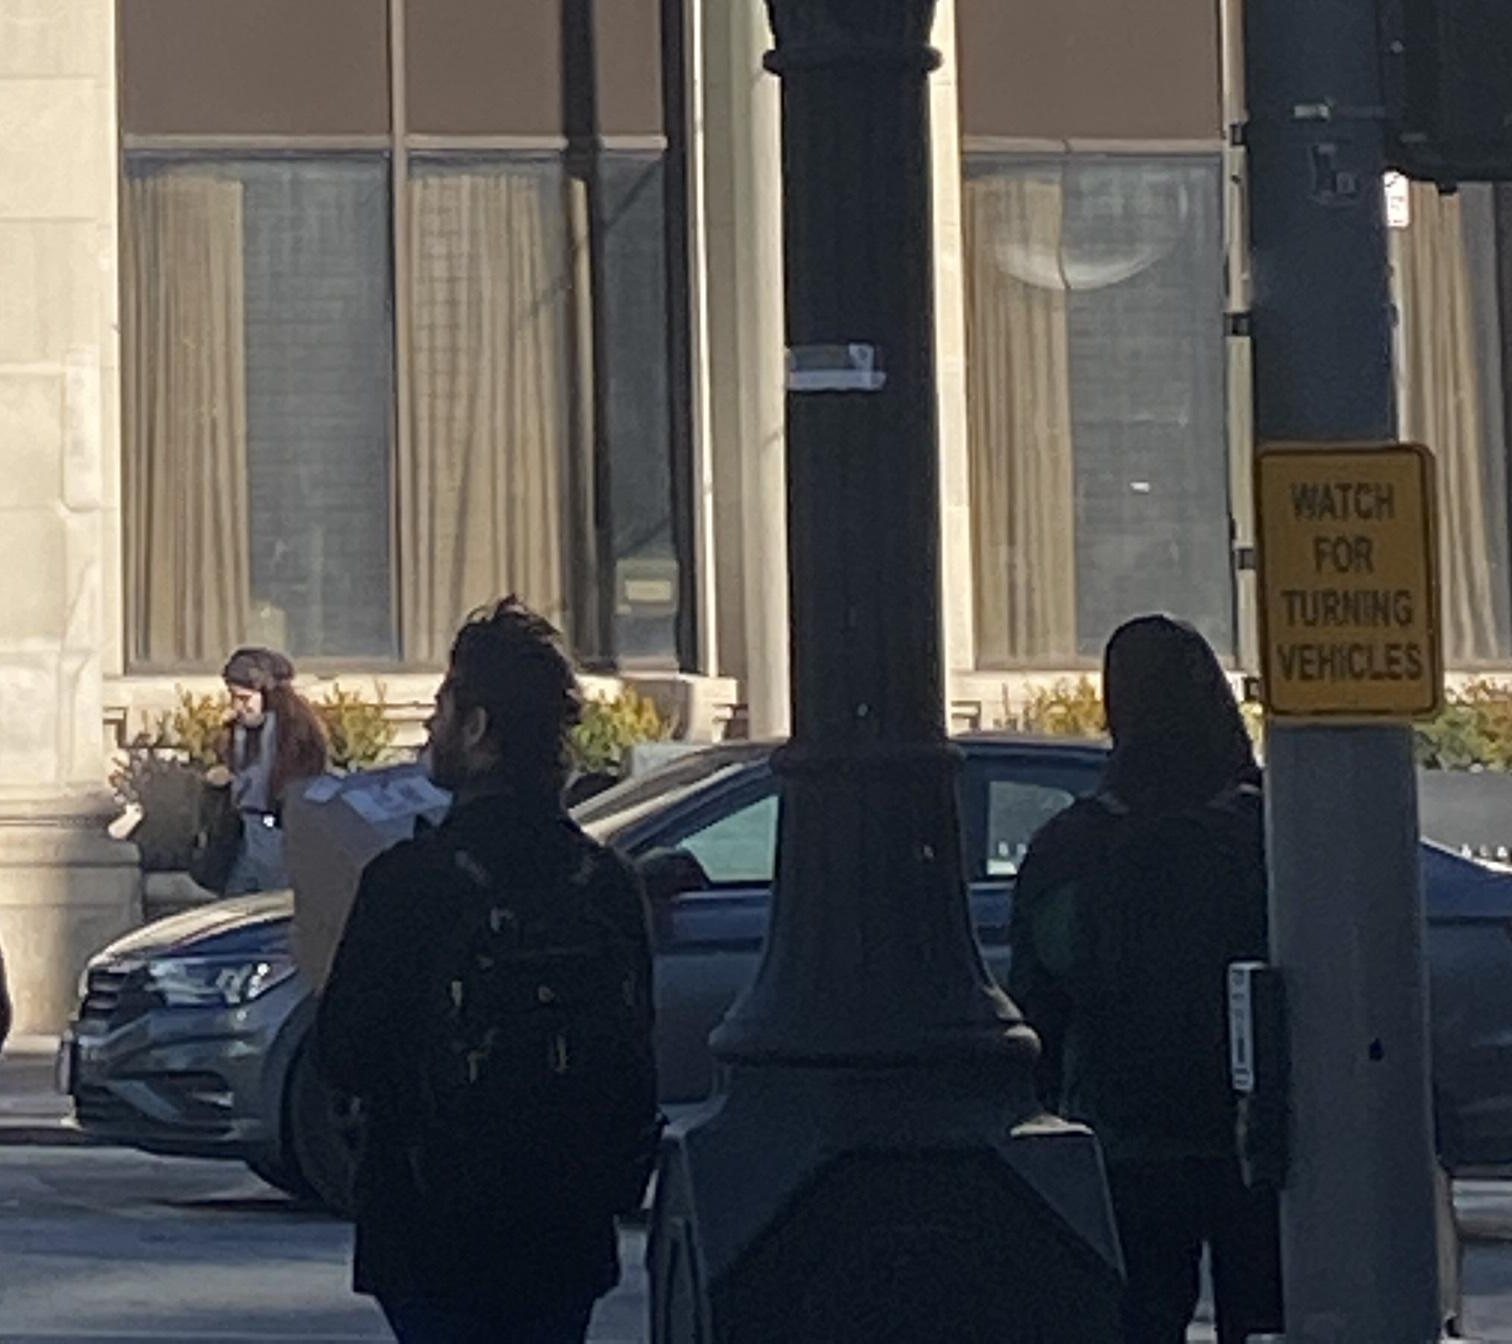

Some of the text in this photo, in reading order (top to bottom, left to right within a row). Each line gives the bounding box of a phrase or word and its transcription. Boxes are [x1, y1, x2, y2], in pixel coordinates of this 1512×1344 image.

[1290, 481, 1395, 522] WATCH
[1312, 535, 1375, 574] FOR
[1280, 588, 1414, 628] TURNING
[1276, 642, 1424, 683] VEHICLES
